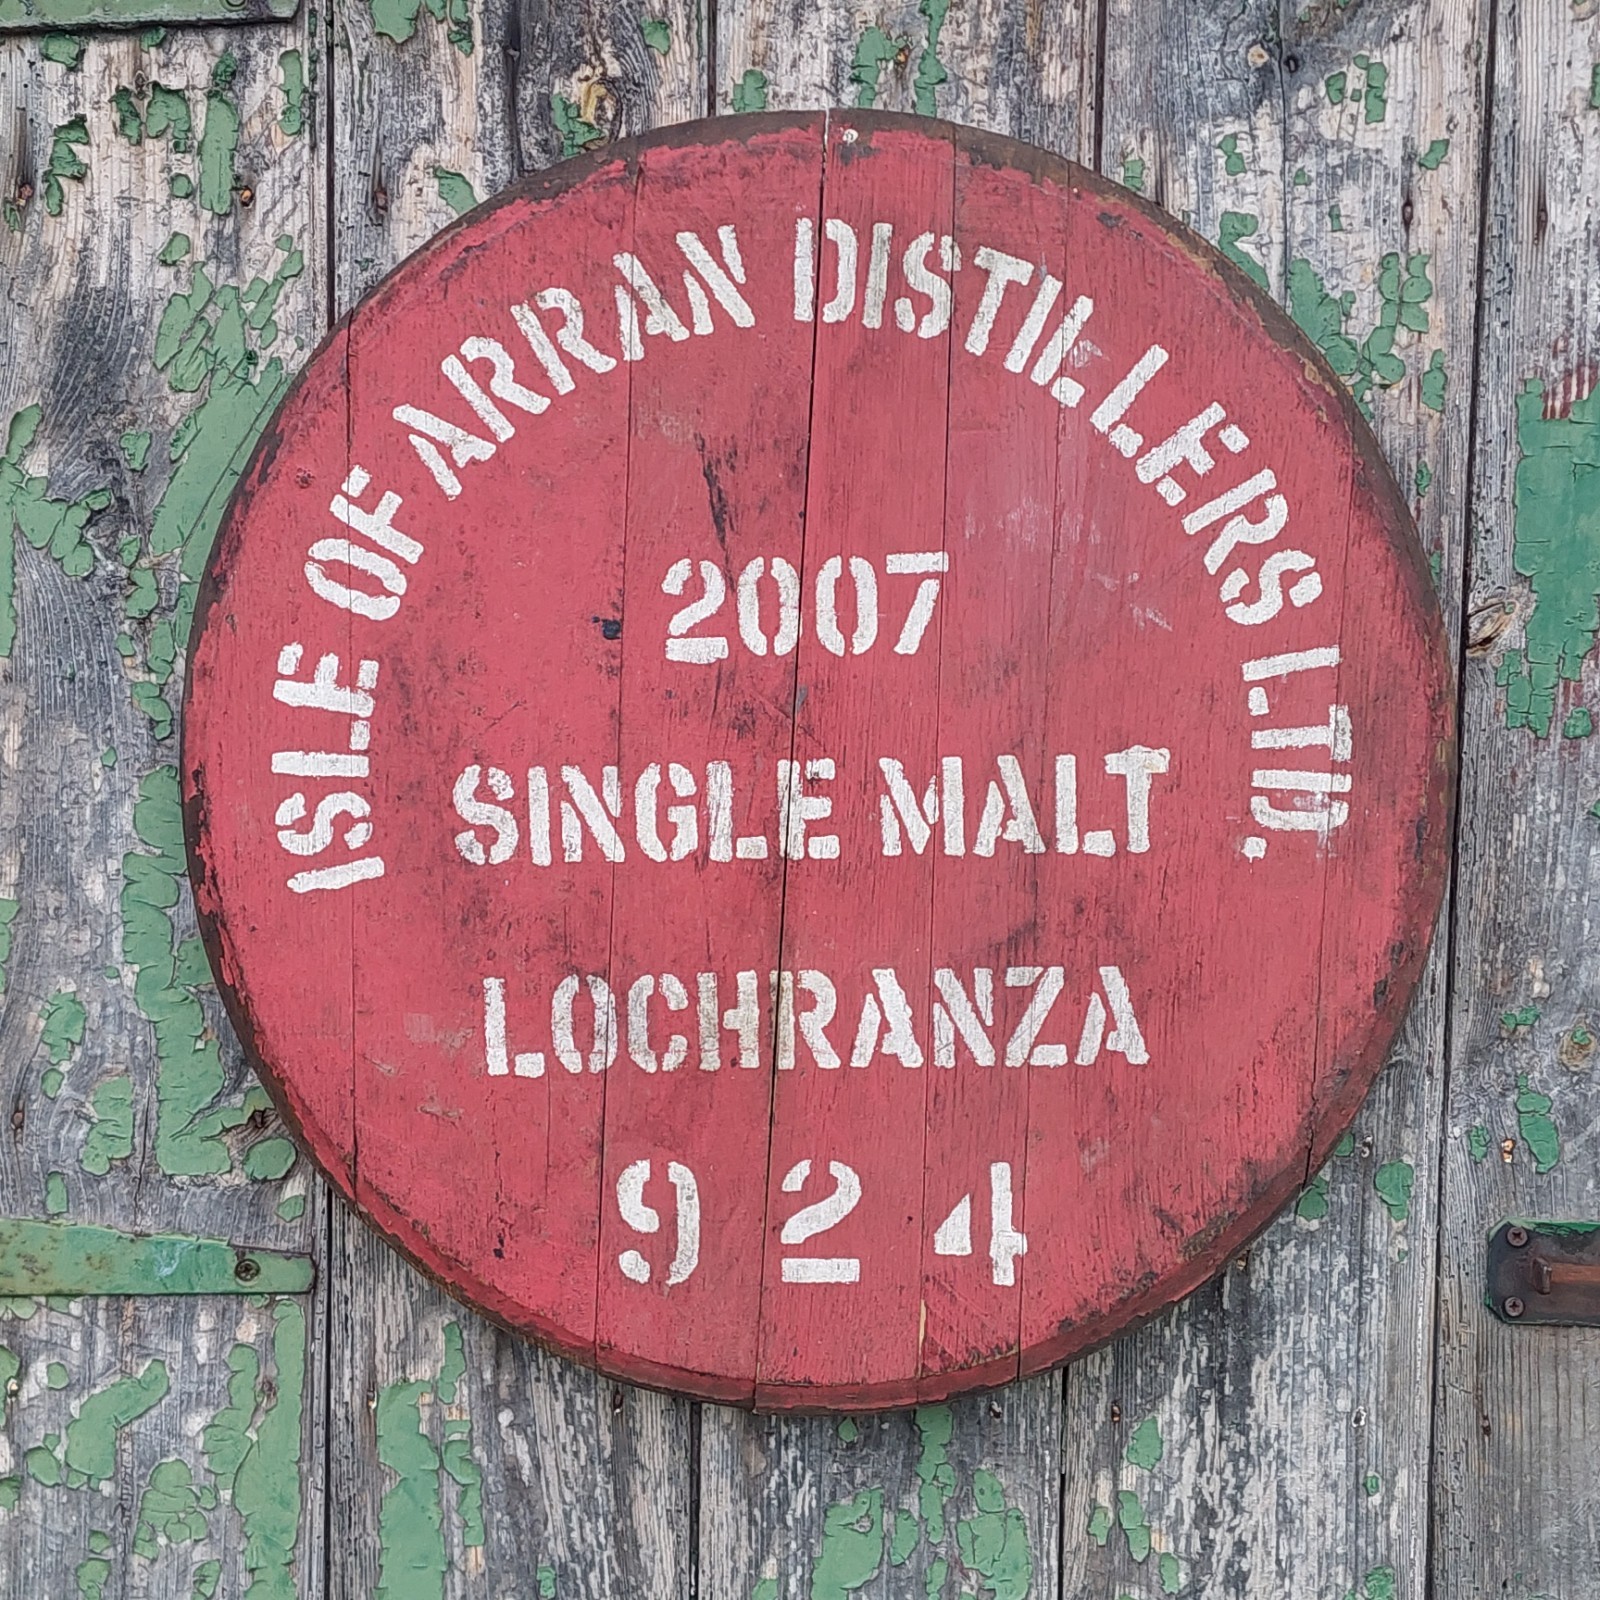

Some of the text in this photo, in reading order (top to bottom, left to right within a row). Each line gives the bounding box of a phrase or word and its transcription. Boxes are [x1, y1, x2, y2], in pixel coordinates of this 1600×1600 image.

[392, 224, 756, 501] ARRAN
[793, 217, 1324, 626] DISTILLERS
[303, 464, 425, 621] OF
[661, 550, 950, 665] 2007
[272, 641, 385, 894] ISLE
[453, 745, 1171, 866] SINGLE MALT
[482, 965, 1151, 1078] LOCHRANZA
